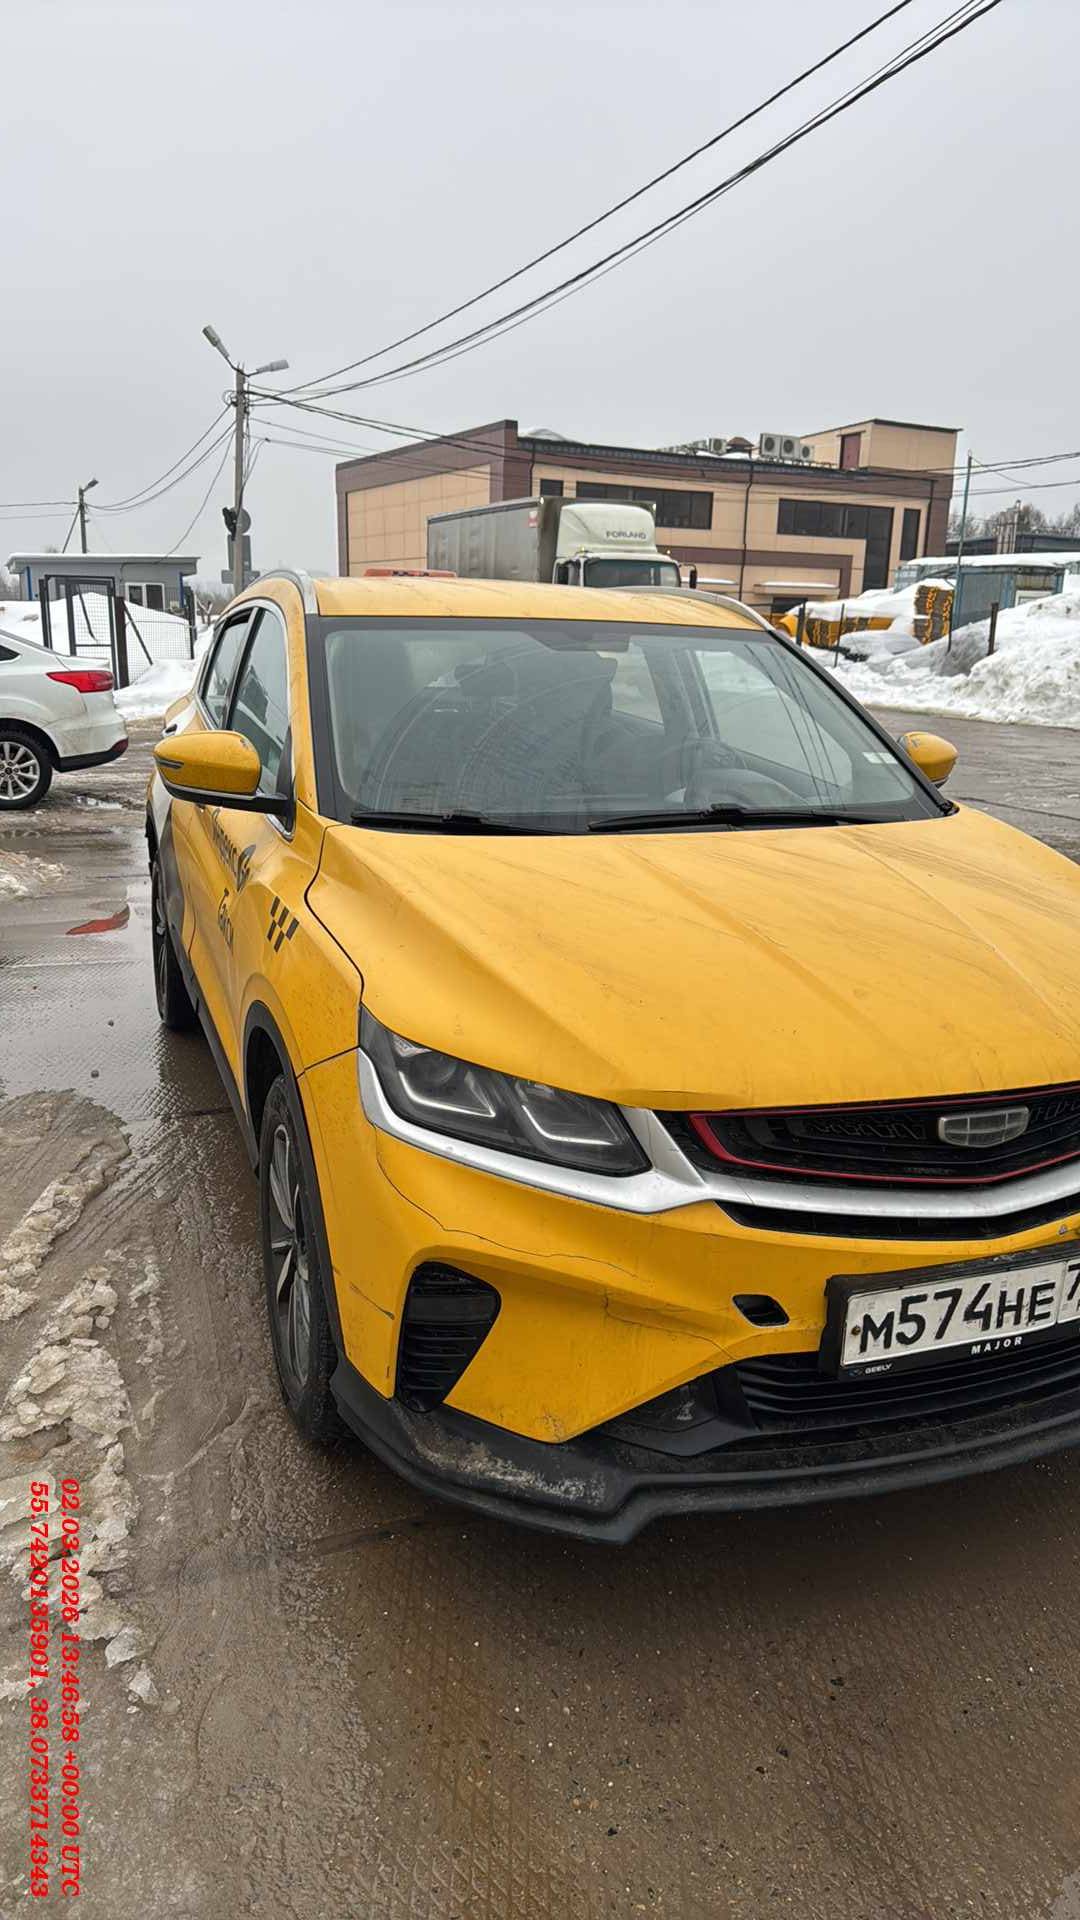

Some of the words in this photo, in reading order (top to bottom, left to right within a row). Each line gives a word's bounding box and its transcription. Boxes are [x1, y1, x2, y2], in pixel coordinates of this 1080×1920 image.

[606, 530, 647, 540] FORLAND
[859, 1282, 1056, 1354] М574НЕ
[971, 1336, 1023, 1355] MAJOR
[865, 1363, 893, 1374] GEELY
